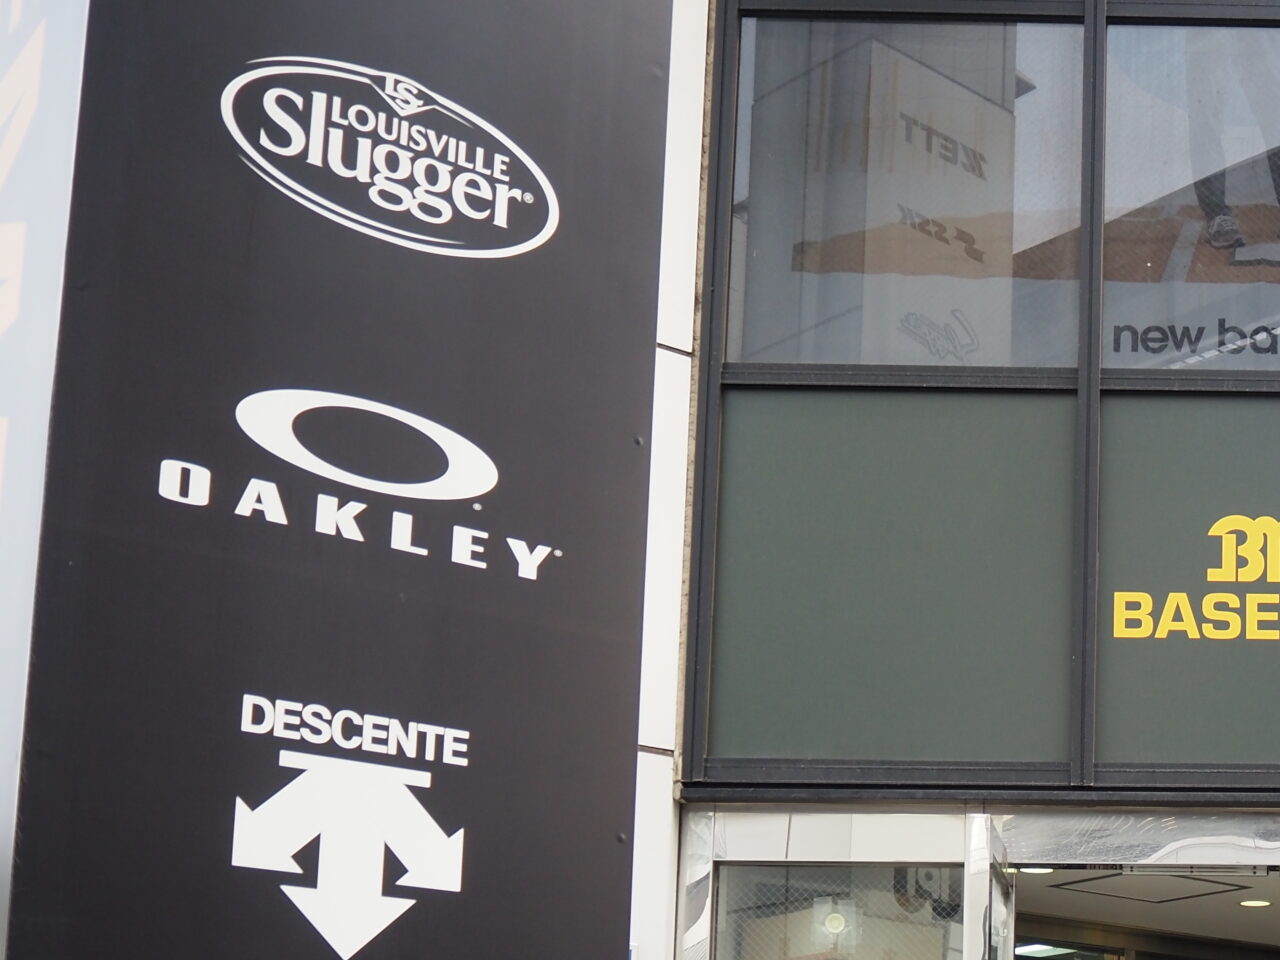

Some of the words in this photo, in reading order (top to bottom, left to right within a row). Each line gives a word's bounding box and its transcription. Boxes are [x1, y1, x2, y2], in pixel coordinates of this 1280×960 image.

[258, 86, 521, 228] Slugger
[331, 95, 511, 183] LOUISVILLE
[1113, 321, 1205, 355] new
[158, 458, 553, 580] OAKLEY
[240, 693, 470, 767] DESCENTE
